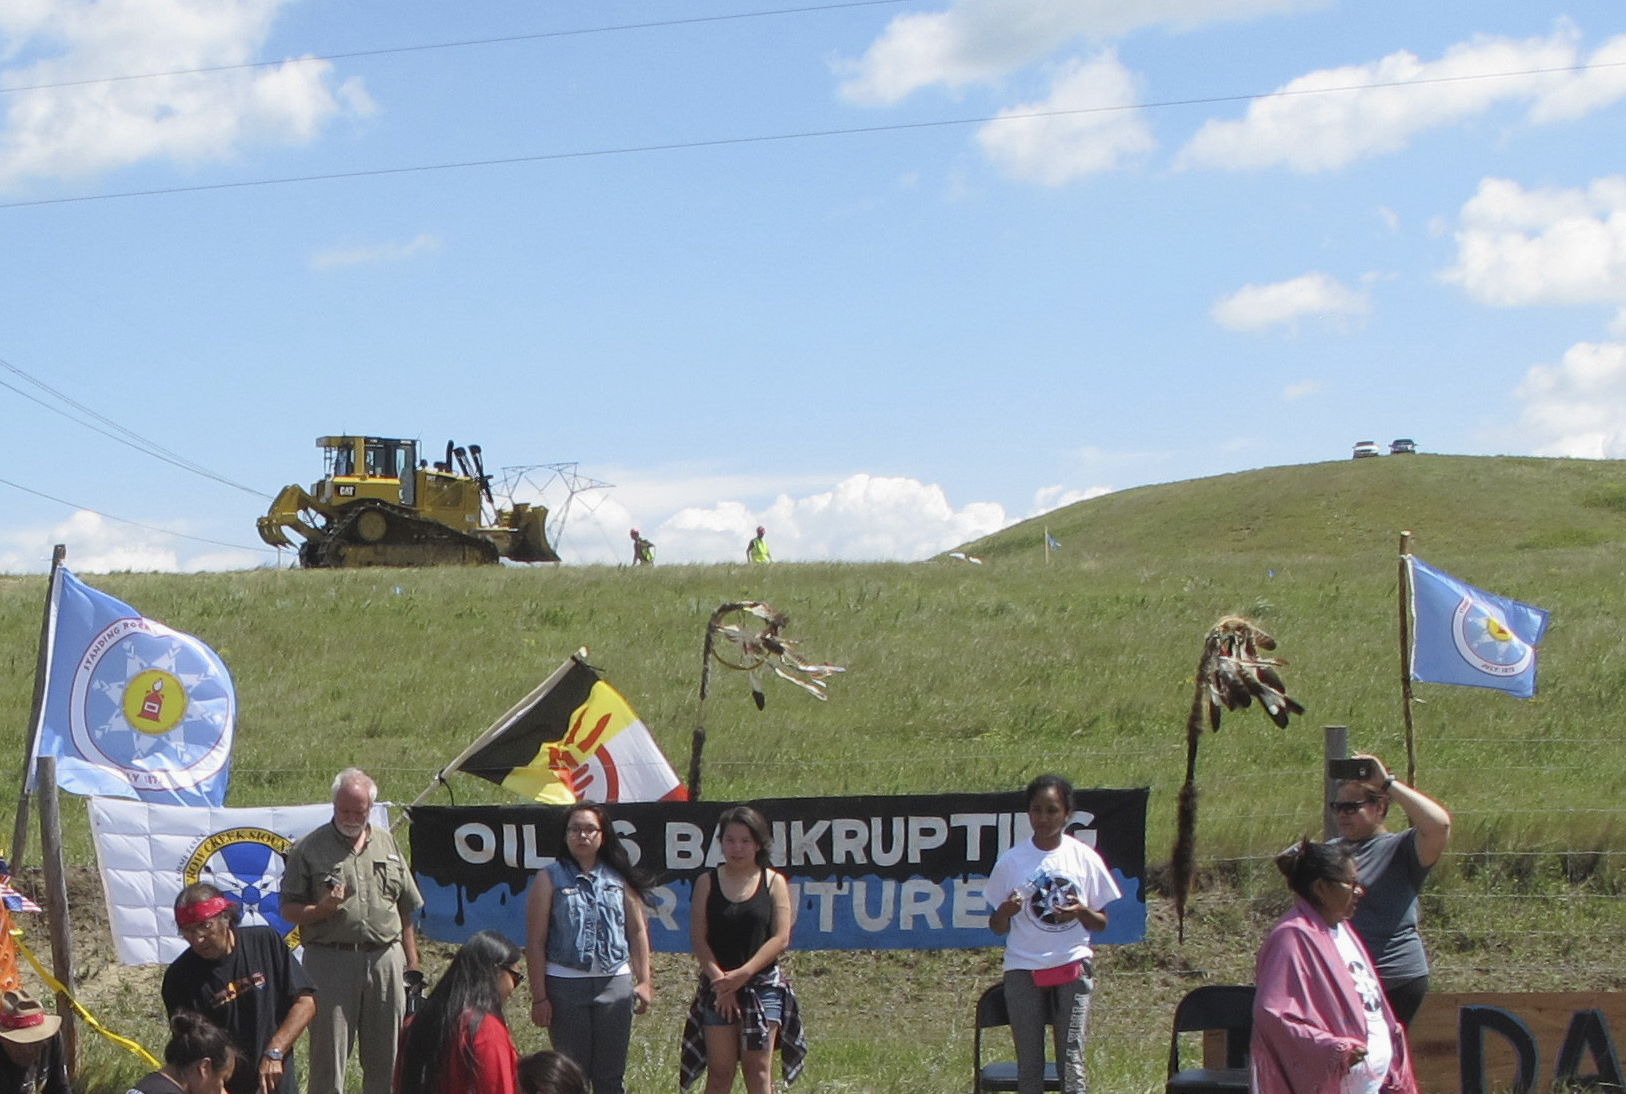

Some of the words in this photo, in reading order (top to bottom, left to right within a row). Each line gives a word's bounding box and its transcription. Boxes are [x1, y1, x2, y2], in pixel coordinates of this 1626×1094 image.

[340, 486, 354, 496] CAT
[83, 627, 120, 671] STANDING
[185, 852, 206, 882] ROW
[203, 830, 245, 853] CREEK
[454, 822, 557, 869] OIL
[1067, 993, 1090, 1043] PINK
